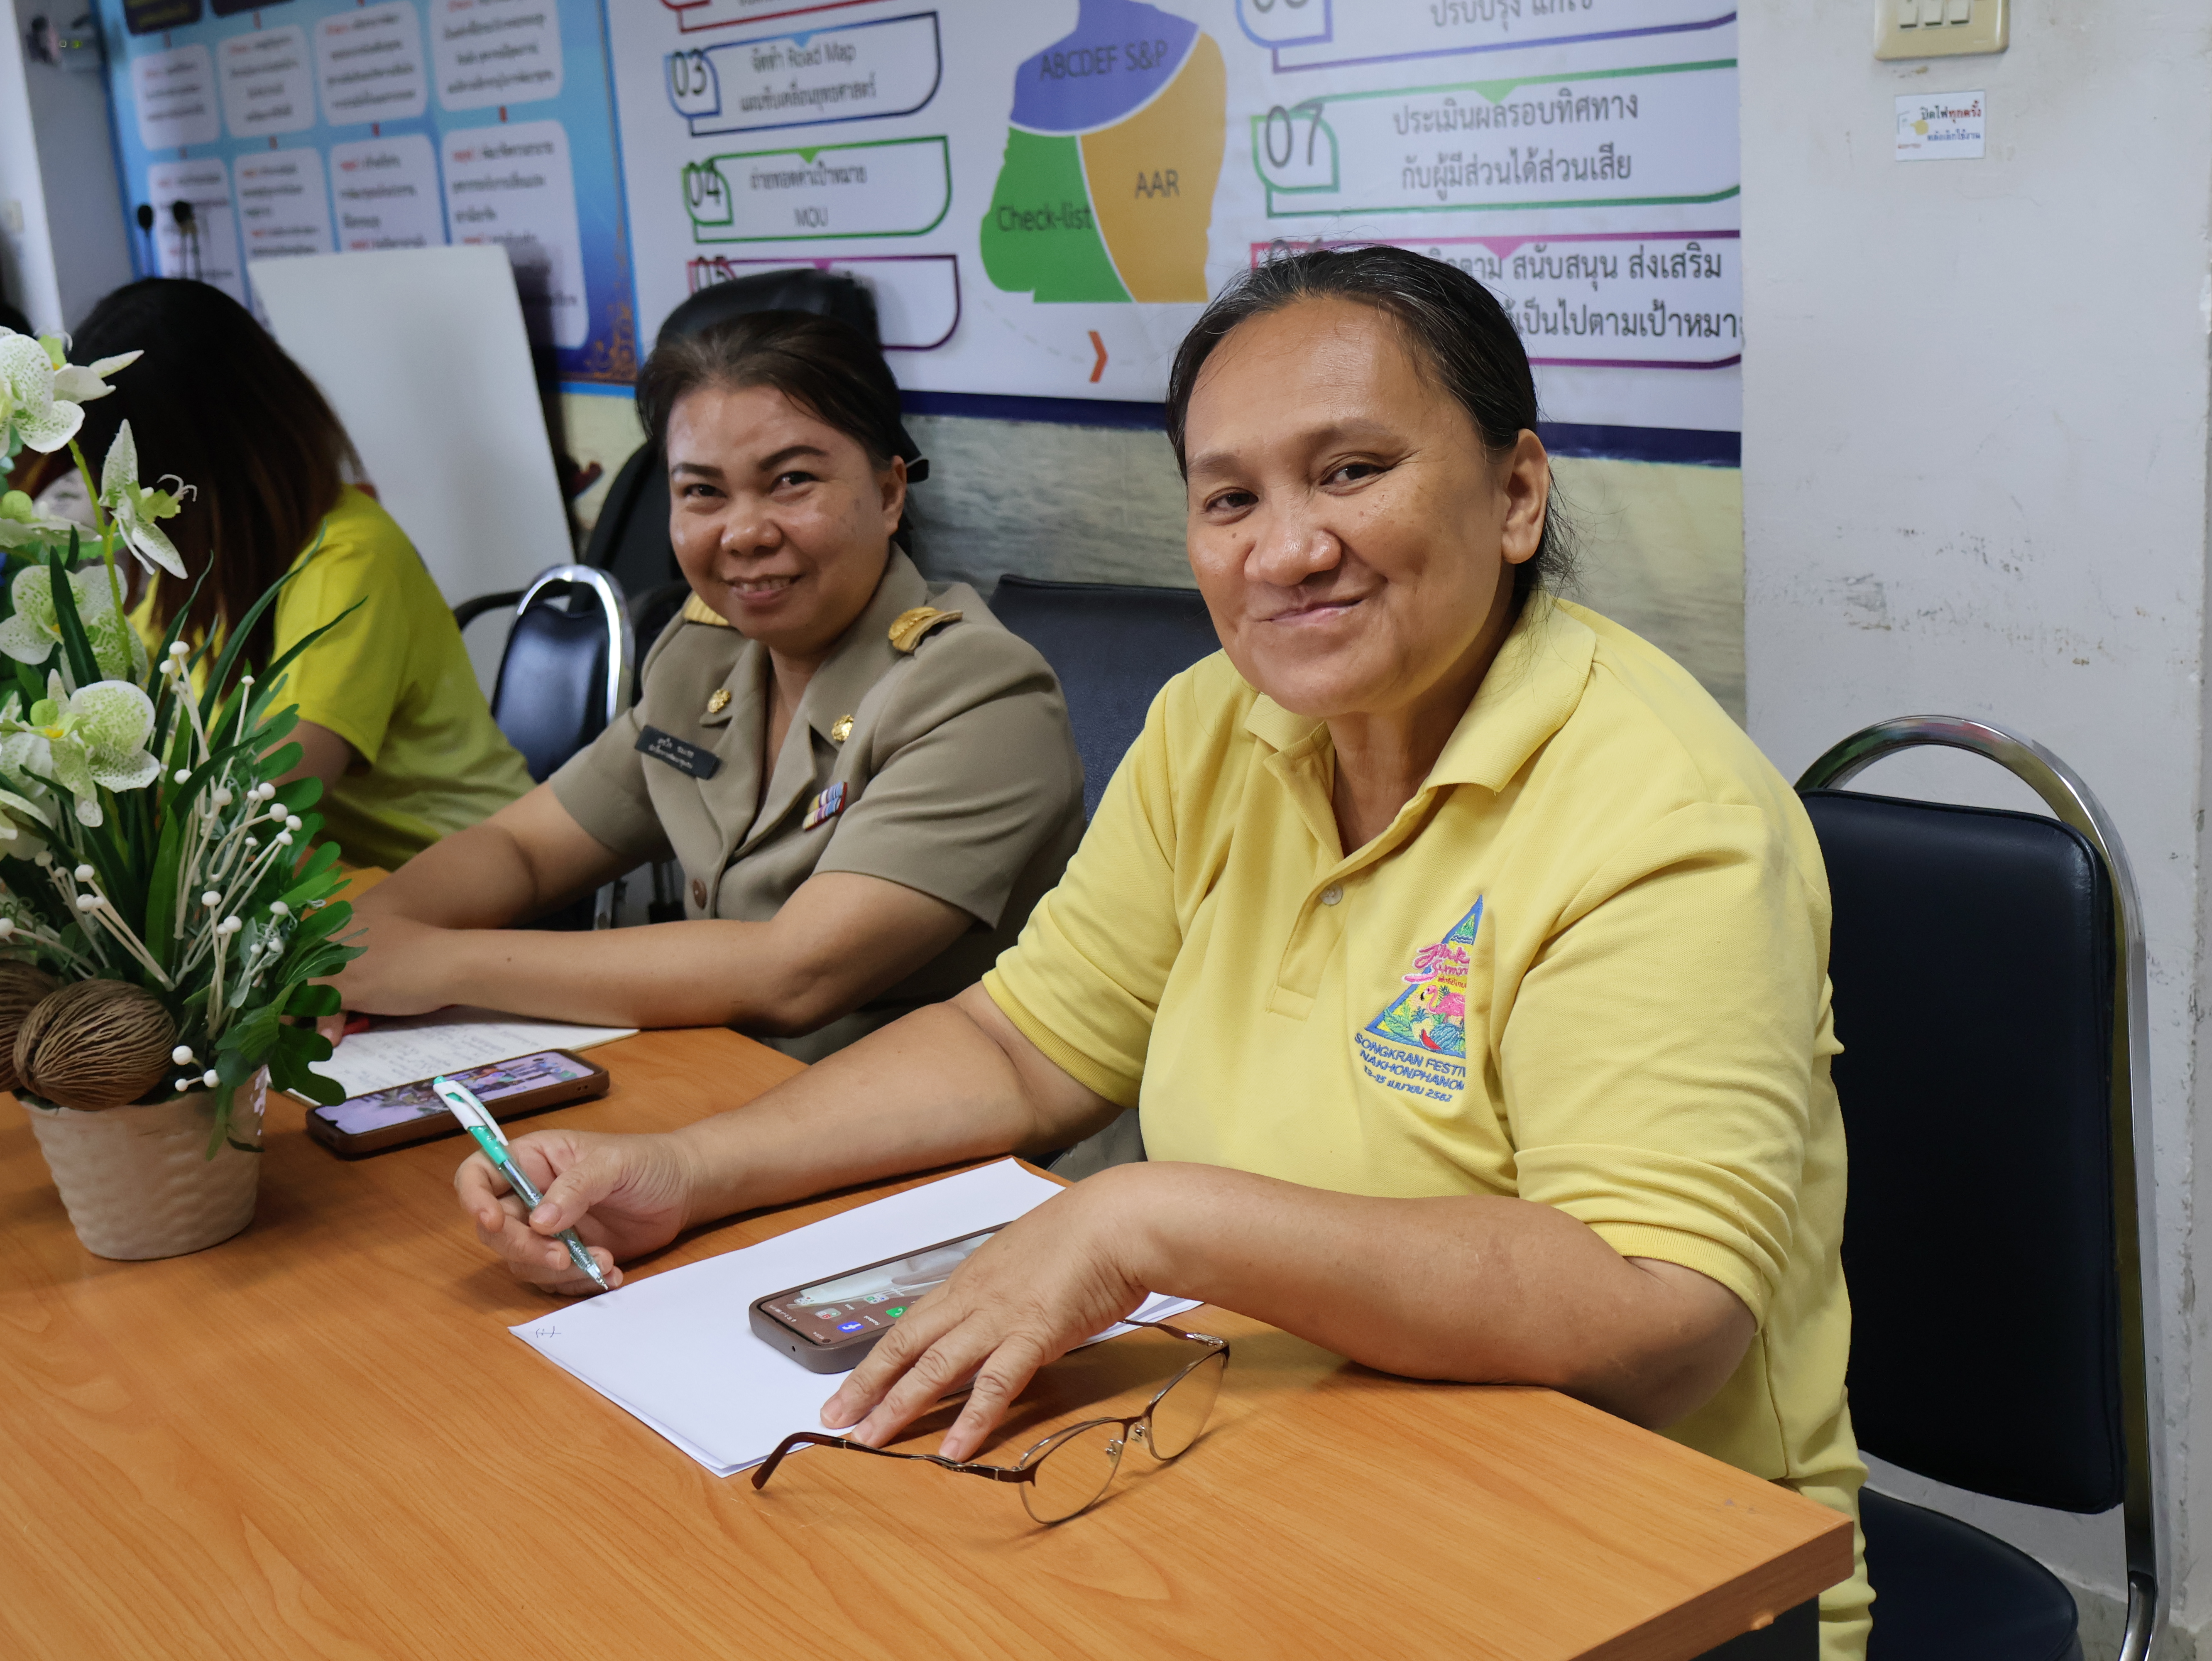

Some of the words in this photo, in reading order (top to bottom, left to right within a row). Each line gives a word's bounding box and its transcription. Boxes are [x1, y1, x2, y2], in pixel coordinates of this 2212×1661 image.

[671, 48, 707, 96] 03
[752, 46, 784, 72] จัดทำ
[788, 47, 821, 69] Road
[825, 42, 856, 65] Map
[1040, 45, 1117, 81] ABCDEF
[1125, 39, 1167, 71] S&P
[1393, 87, 1639, 135] ประเมินผลรอบทิศทาง
[1920, 100, 1982, 124] ปิดไฟทุกครั้ง
[1266, 102, 1323, 167] 07
[686, 162, 722, 206] 04
[1135, 168, 1179, 199] AAR
[1402, 141, 1632, 201] กับผู้มีส่วนได้ส่วนเสีย
[794, 207, 828, 228] MOU
[998, 201, 1092, 231] Check-list
[1512, 242, 1618, 291] สนับสนุน
[1628, 242, 1722, 279] ส่งเสริม
[1354, 1032, 1424, 1067] SONGKRAN
